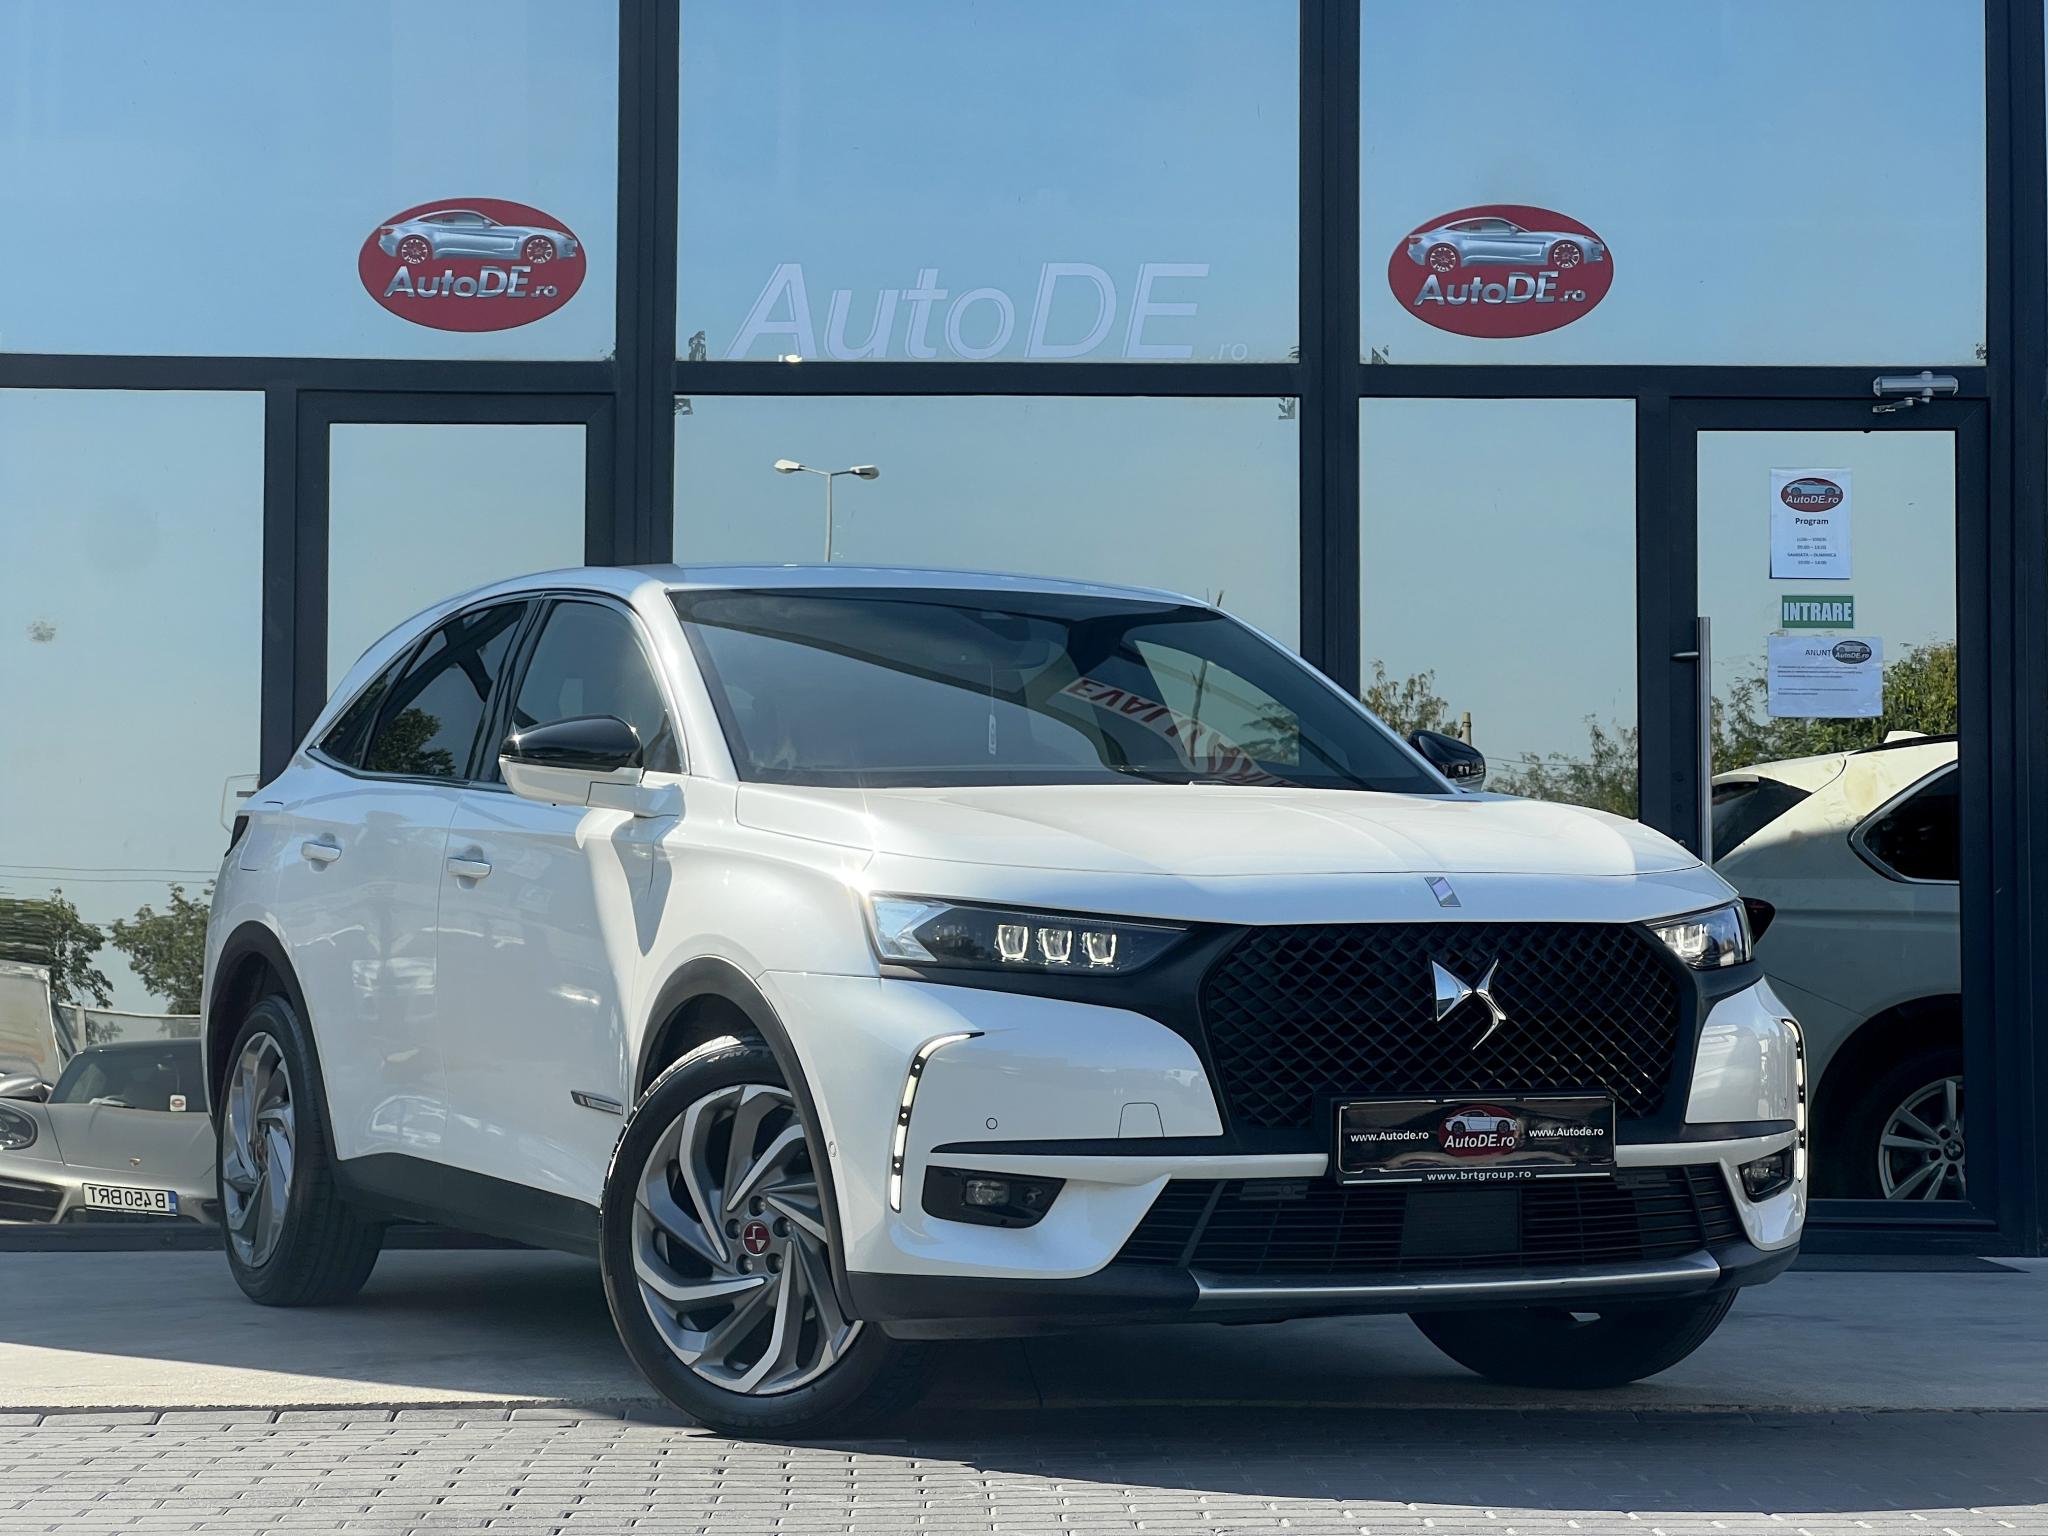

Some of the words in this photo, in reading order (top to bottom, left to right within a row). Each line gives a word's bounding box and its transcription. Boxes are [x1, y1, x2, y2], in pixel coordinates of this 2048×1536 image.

[1785, 495, 1839, 504] AutoDE.ro
[1795, 517, 1829, 526] Program
[1783, 602, 1853, 621] INTRARE
[1350, 1131, 1429, 1142] www.Autode.ro
[1444, 1134, 1516, 1149] AutoDE.ro
[1528, 1127, 1604, 1138] www.Autode.ro
[1427, 1170, 1532, 1181] www.brtgroup.ro
